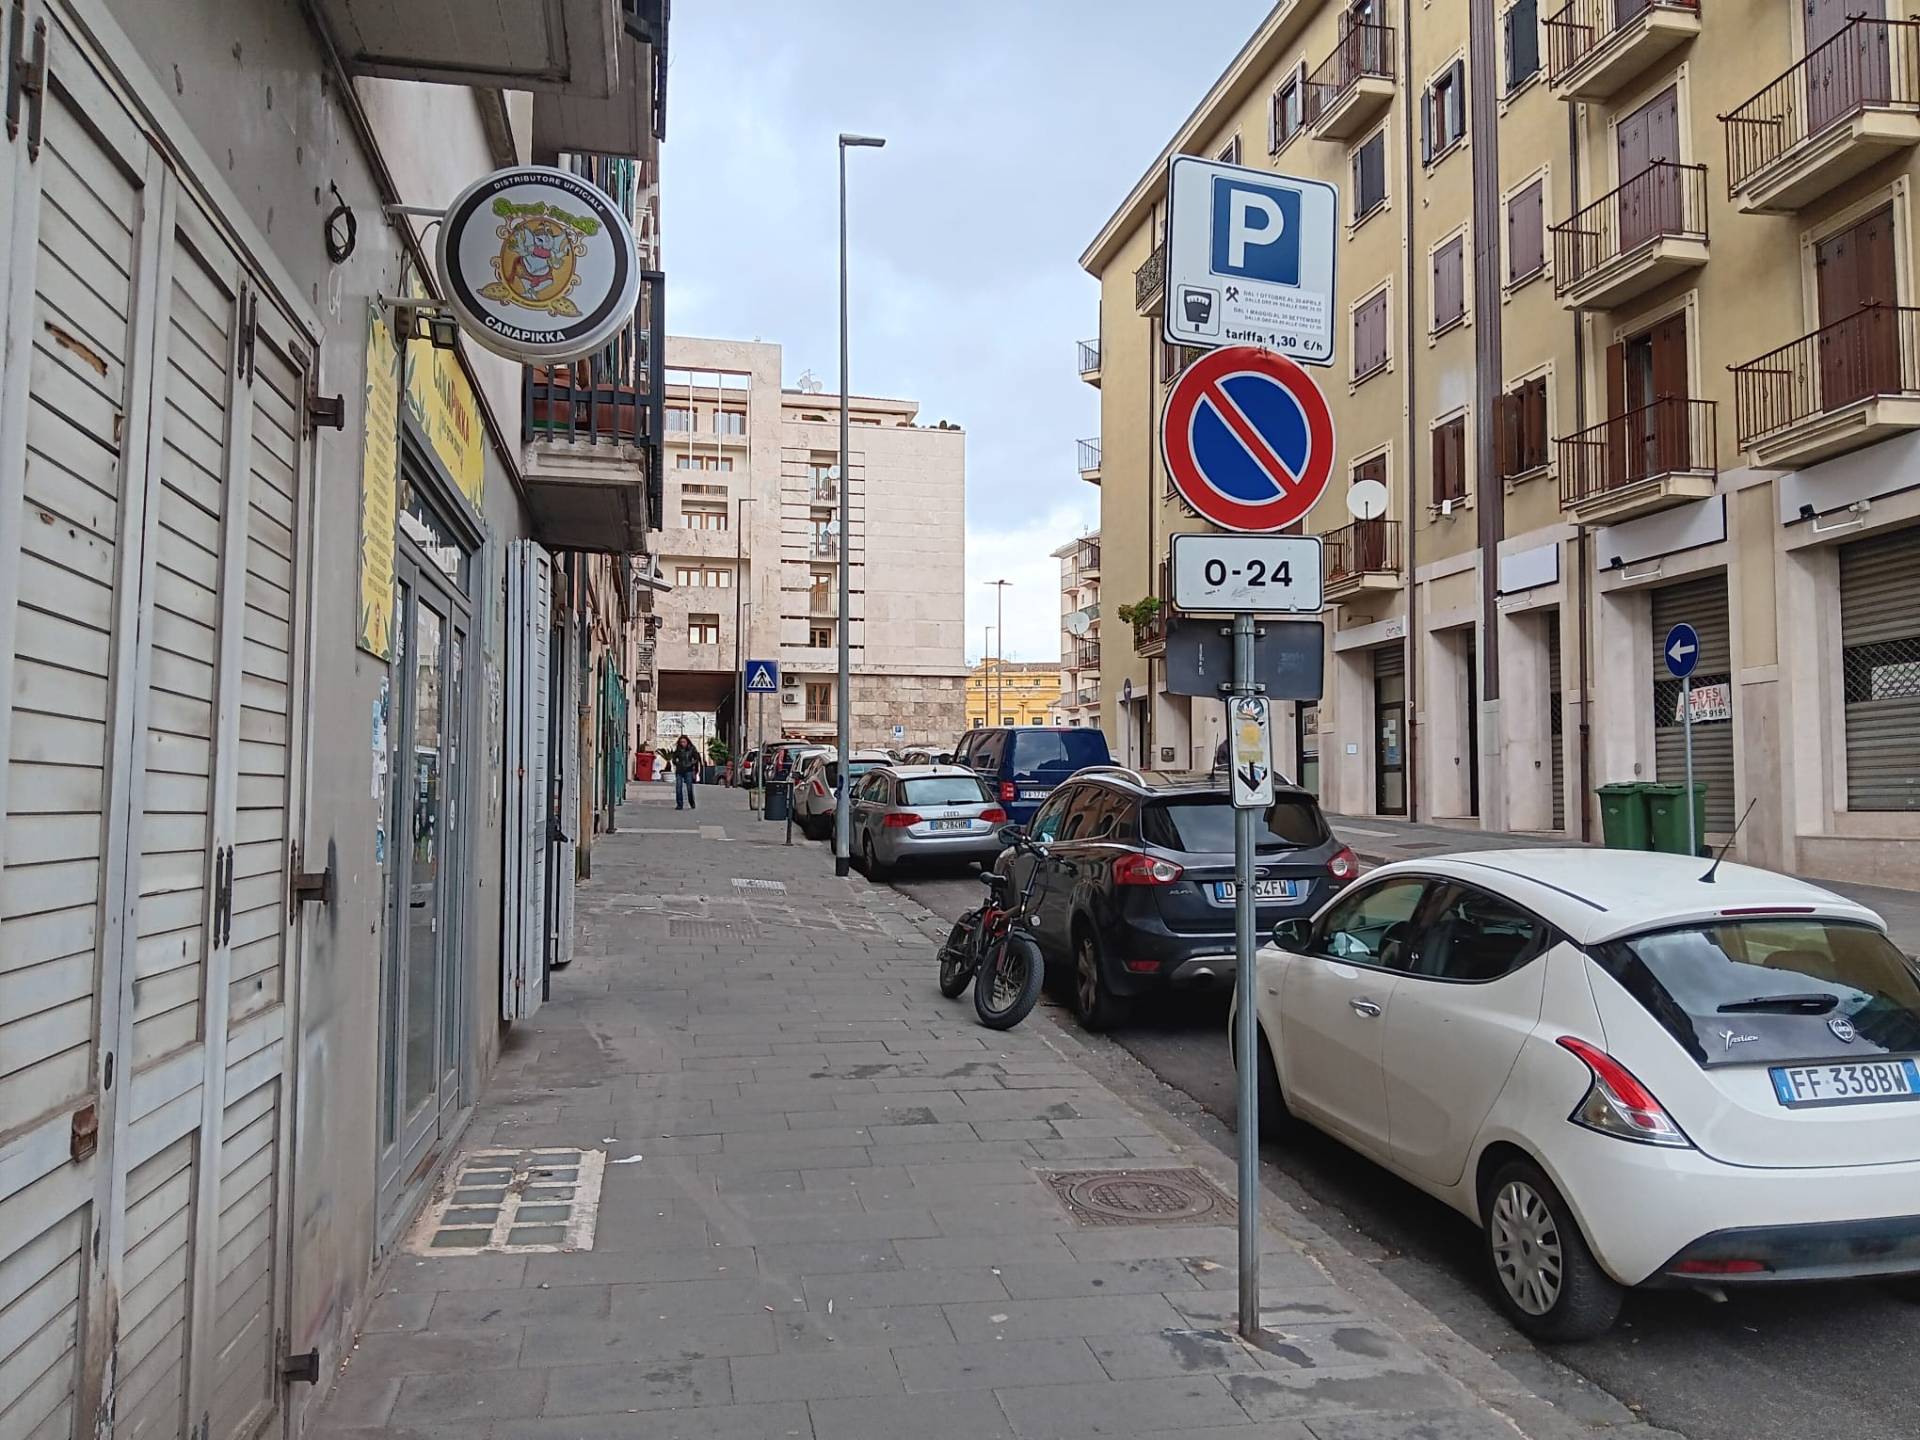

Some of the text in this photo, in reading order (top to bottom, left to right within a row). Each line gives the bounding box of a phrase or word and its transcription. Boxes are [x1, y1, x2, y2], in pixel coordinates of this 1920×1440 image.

[494, 174, 605, 213] DISTRIBUTORE UFFICIALE
[1228, 188, 1285, 269] P
[484, 316, 566, 343] CANAPIKKA
[1226, 328, 1323, 351] tariffa: 1,30 €/h
[1204, 559, 1293, 587] 0-24
[1689, 688, 1721, 702] EDESI
[1789, 1063, 1908, 1098] FF 338BW
